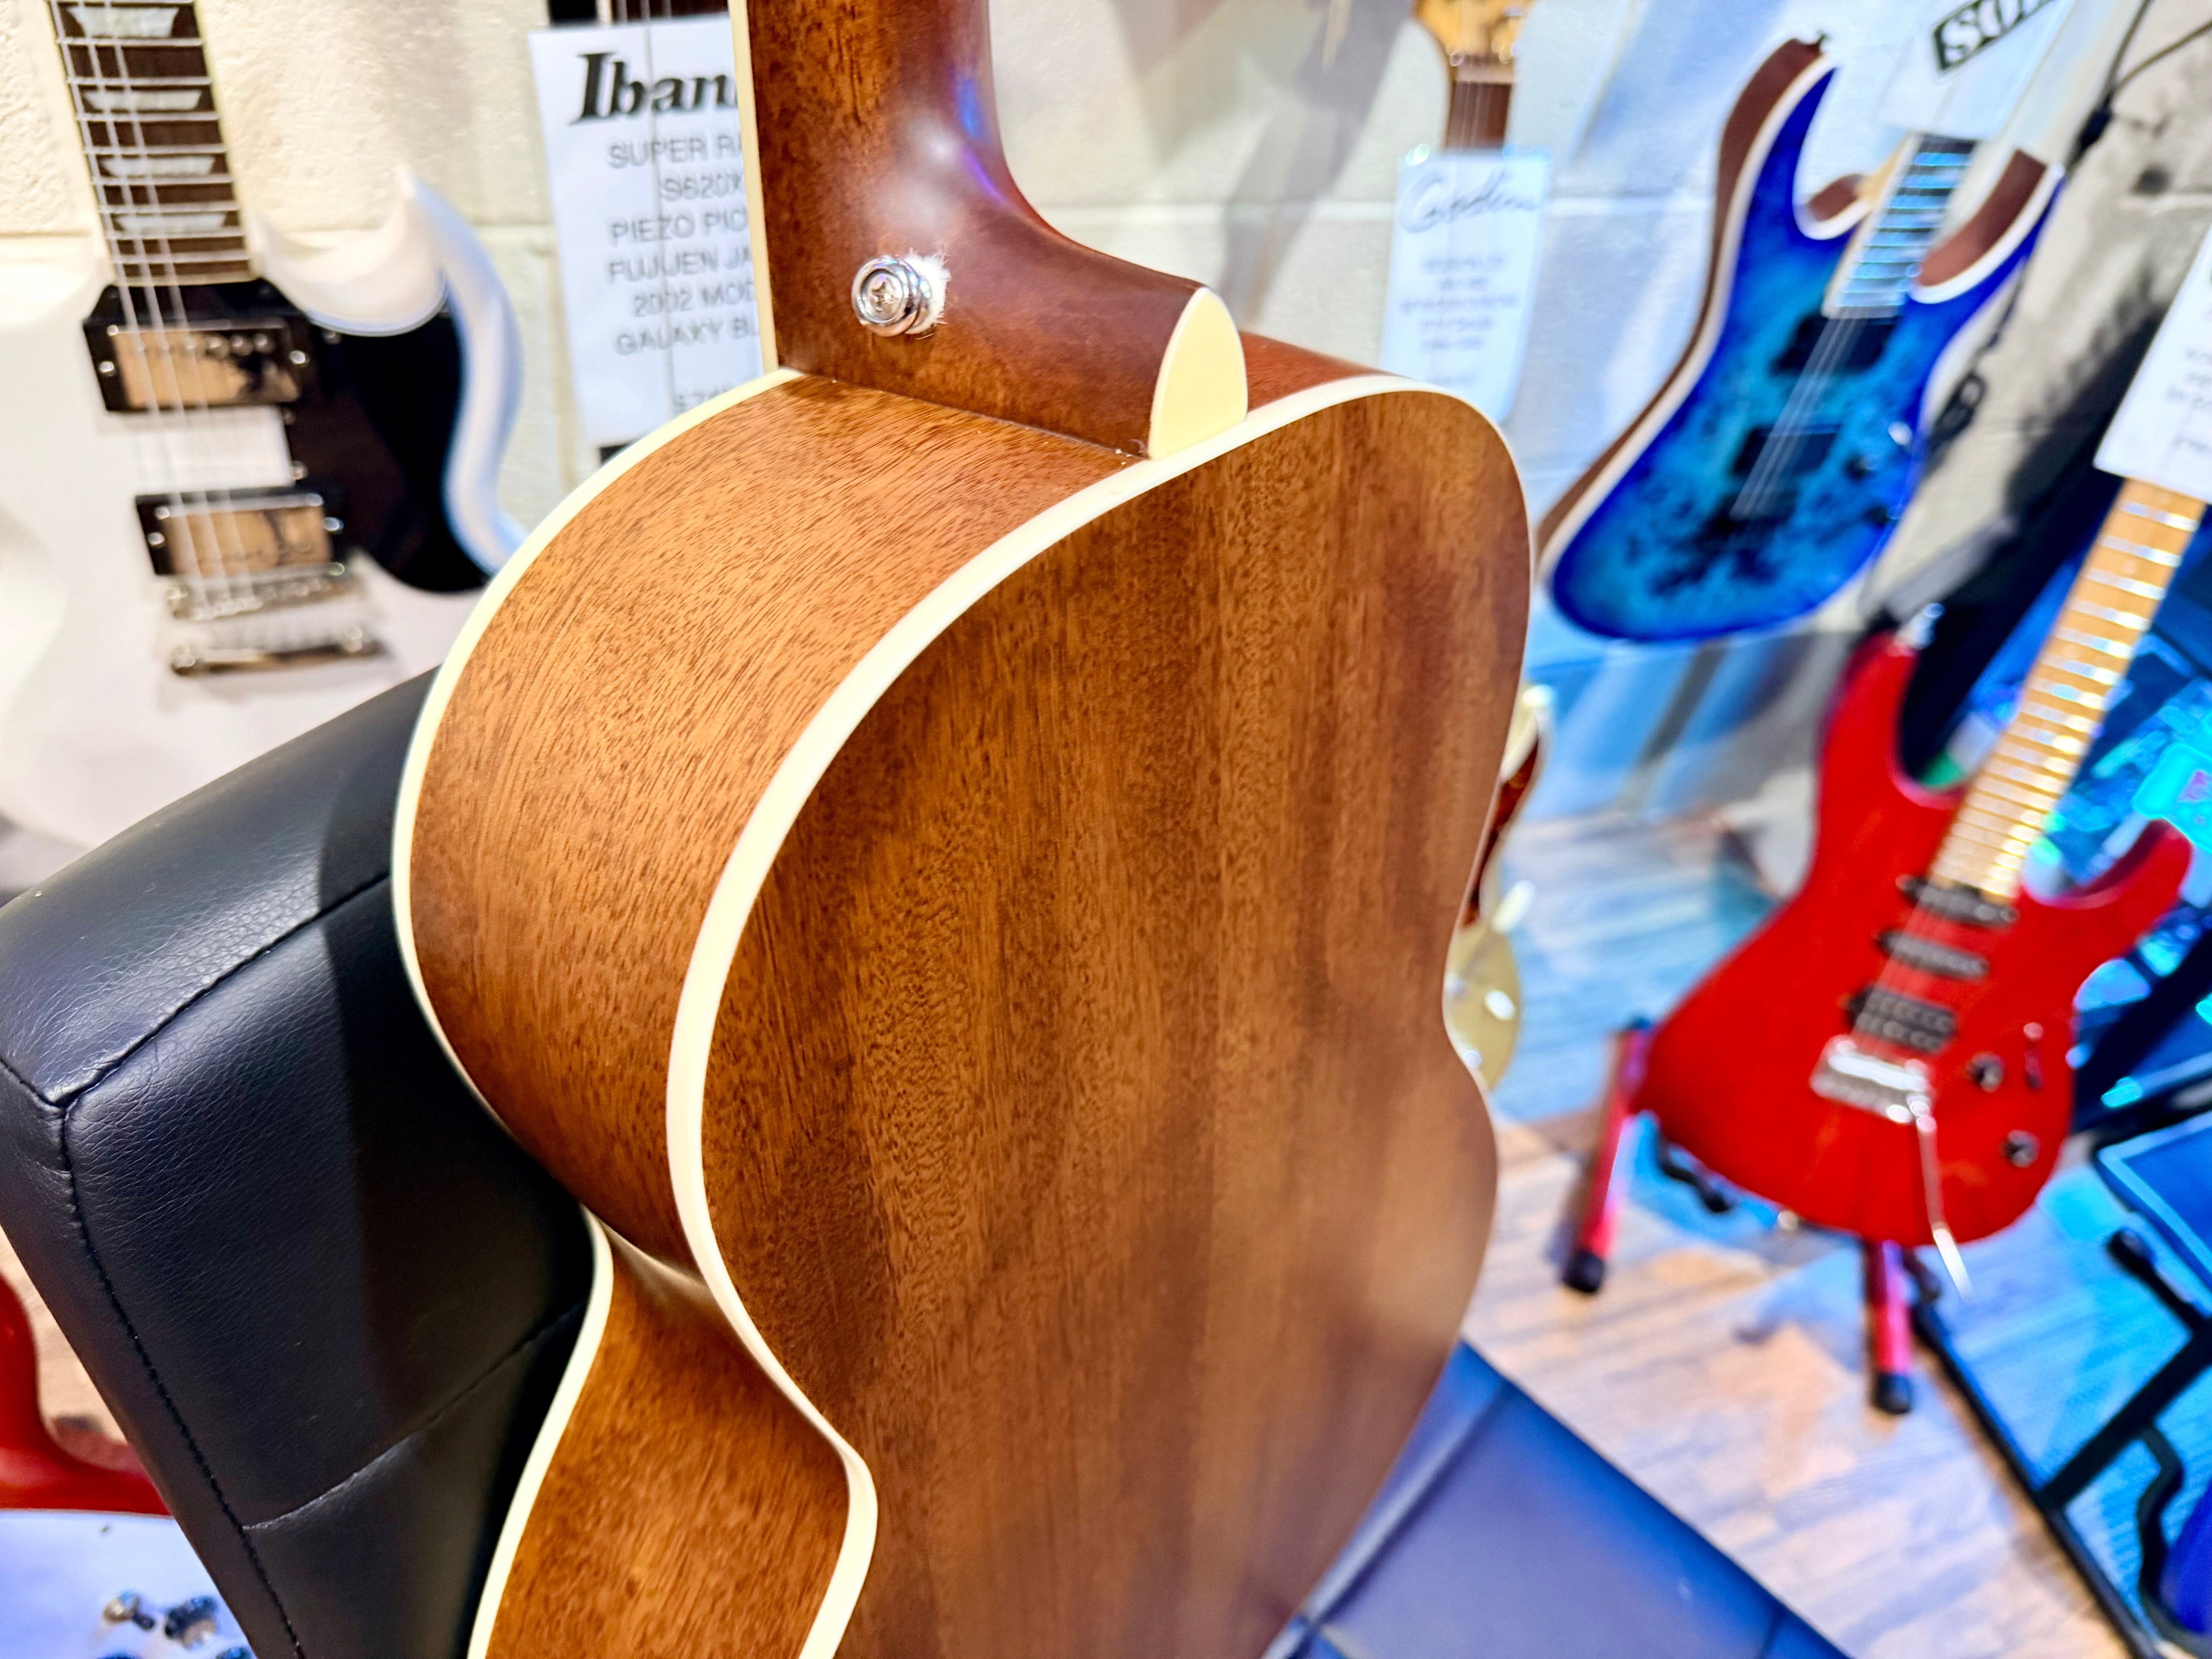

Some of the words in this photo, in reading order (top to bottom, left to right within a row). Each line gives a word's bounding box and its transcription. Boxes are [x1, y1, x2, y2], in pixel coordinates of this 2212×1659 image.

[568, 52, 737, 125] Iban
[608, 137, 707, 168] SUPER
[716, 134, 742, 161] R
[611, 211, 695, 247] PIEZO
[634, 290, 693, 317] 2002
[613, 321, 723, 355] GALAXY
